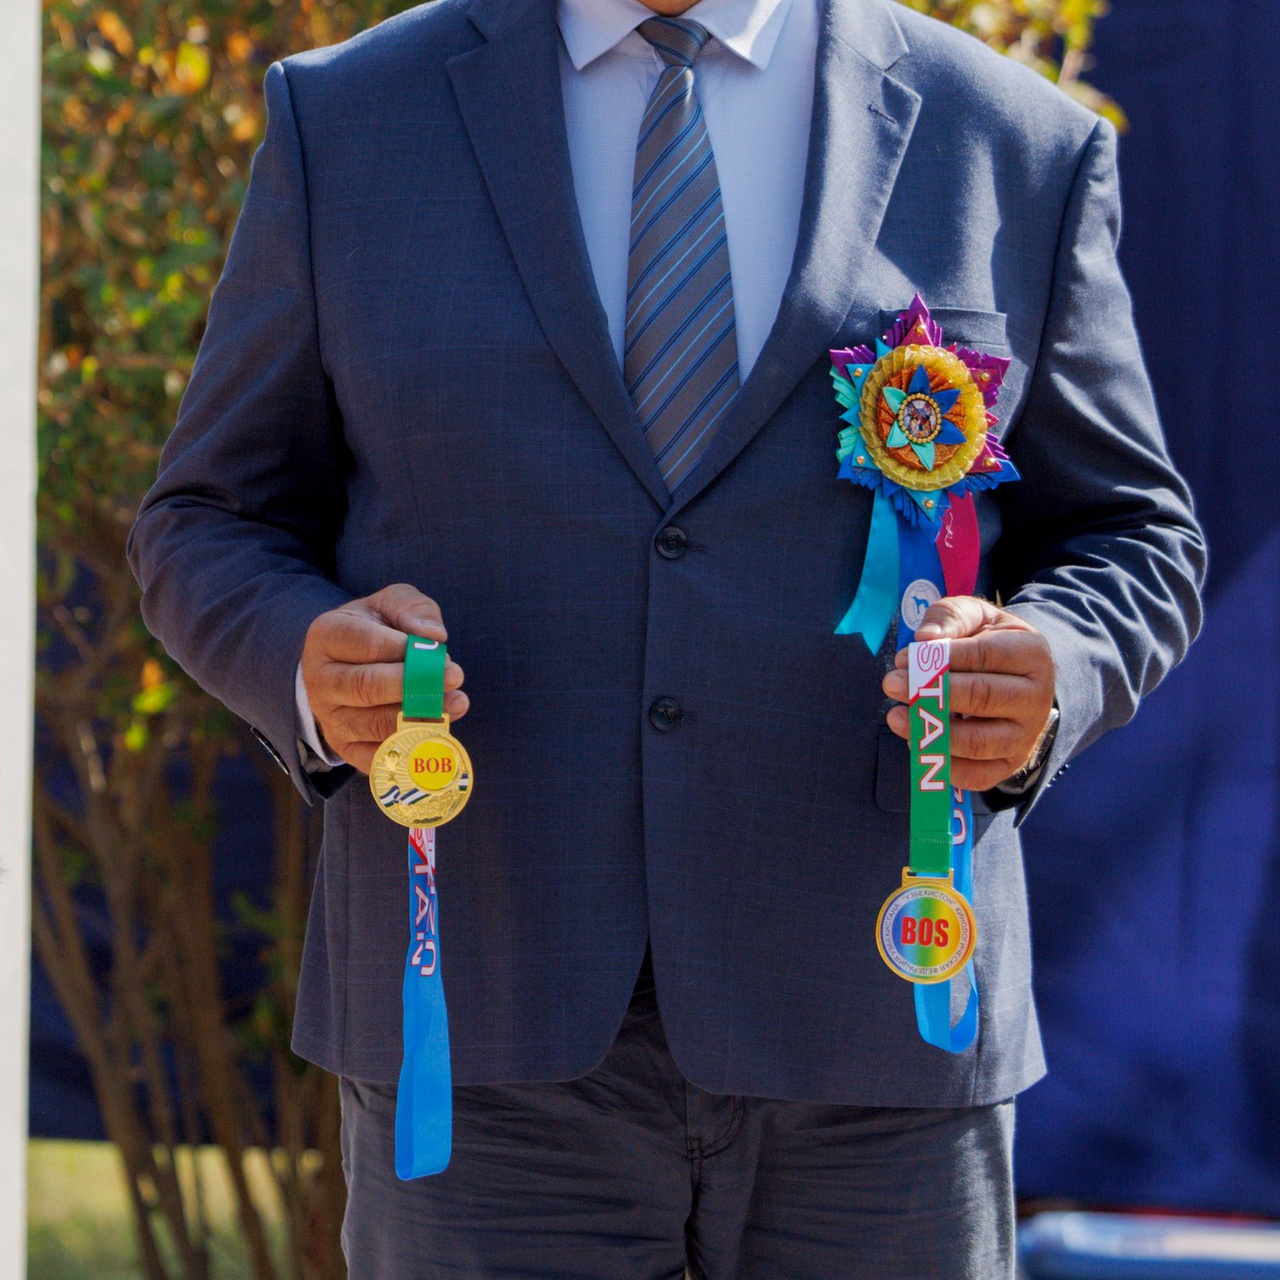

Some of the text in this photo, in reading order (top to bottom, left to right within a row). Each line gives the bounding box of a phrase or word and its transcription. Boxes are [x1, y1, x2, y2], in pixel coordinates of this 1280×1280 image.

[917, 640, 946, 791] STAN
[414, 757, 452, 774] BOB
[901, 916, 949, 947] BOS
